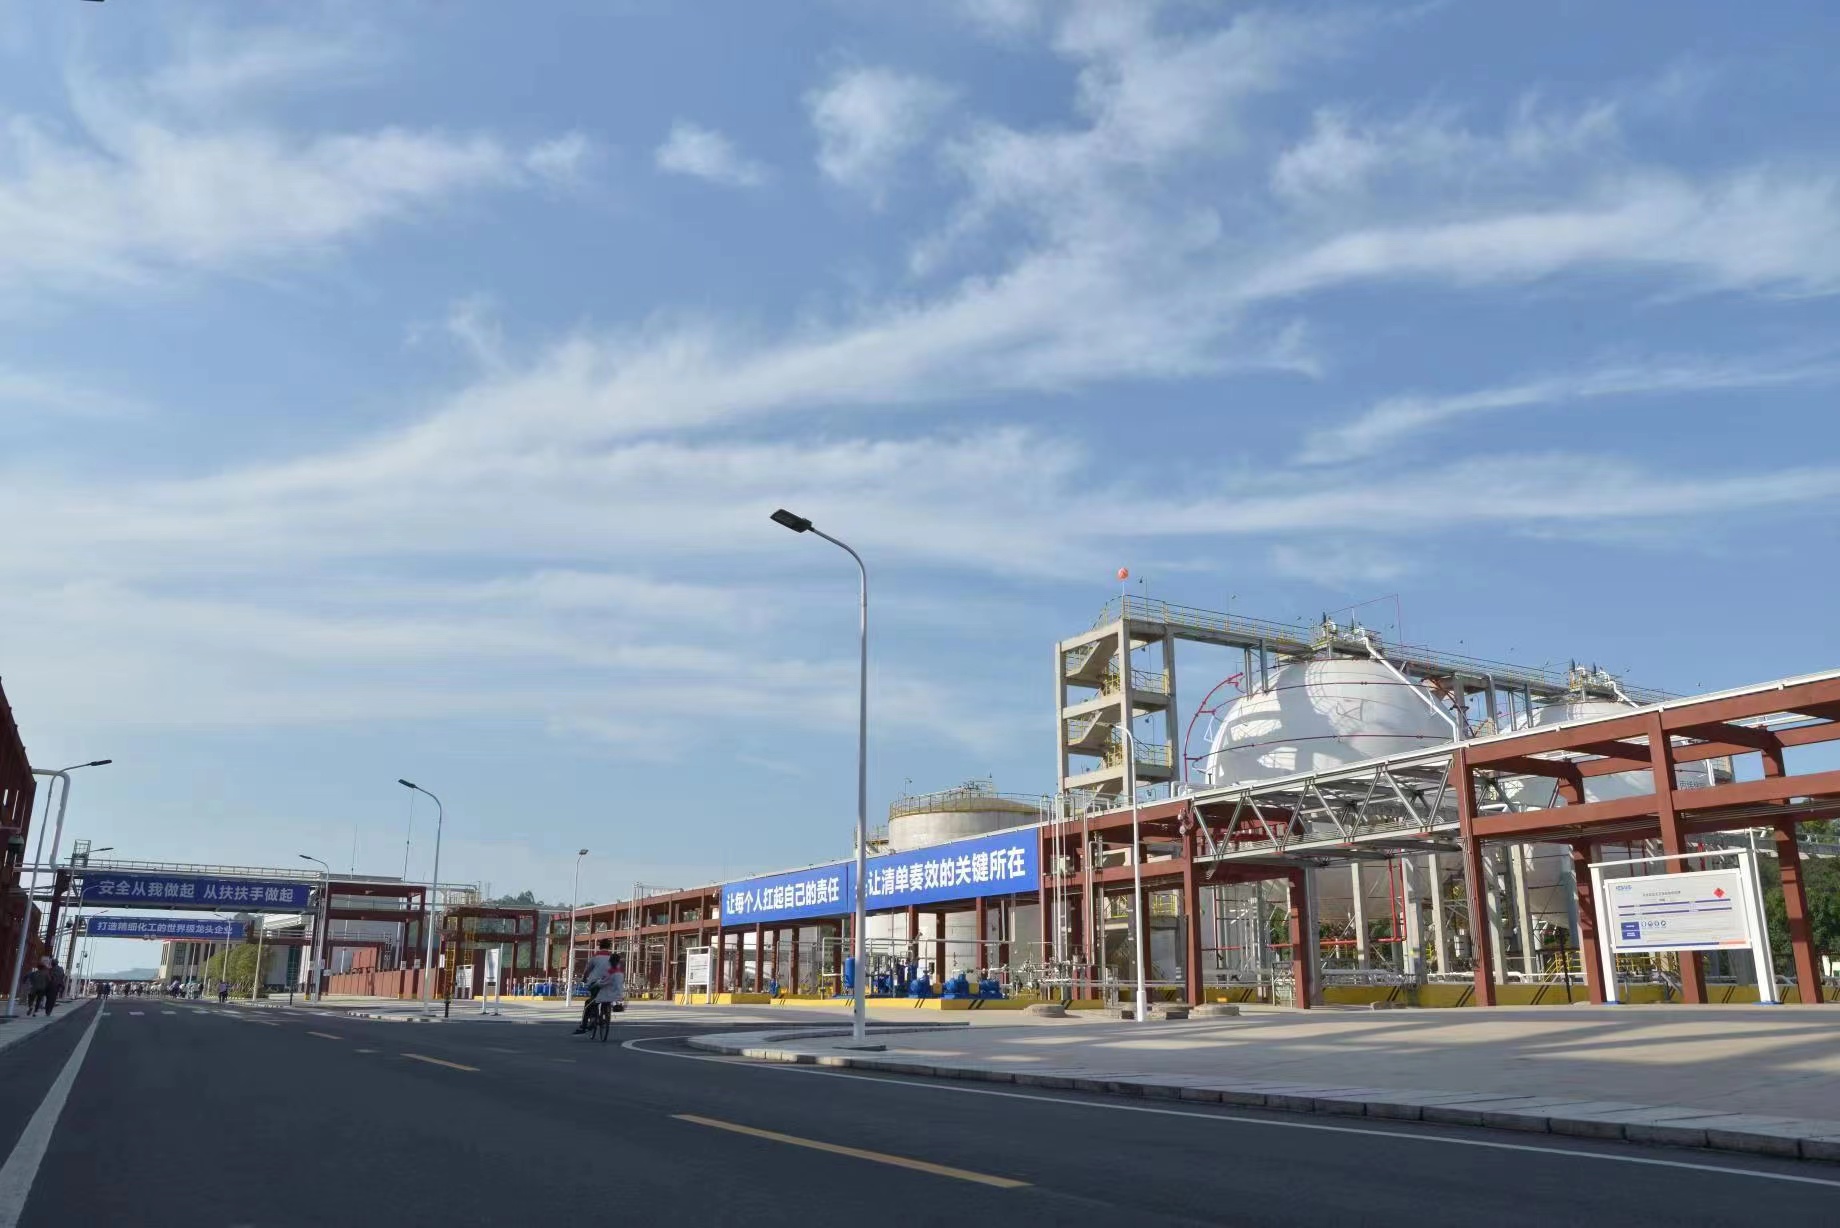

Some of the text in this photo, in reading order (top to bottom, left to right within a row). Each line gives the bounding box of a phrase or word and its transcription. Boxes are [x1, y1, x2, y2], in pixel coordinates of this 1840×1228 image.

[98, 880, 294, 903] 安全从我做起 从扶扶手做起
[726, 846, 1026, 915] 让每个人扛起自己的责任 让清单奏效的关键所在
[97, 921, 233, 935] 打造精细化工的世界级龙头企业
